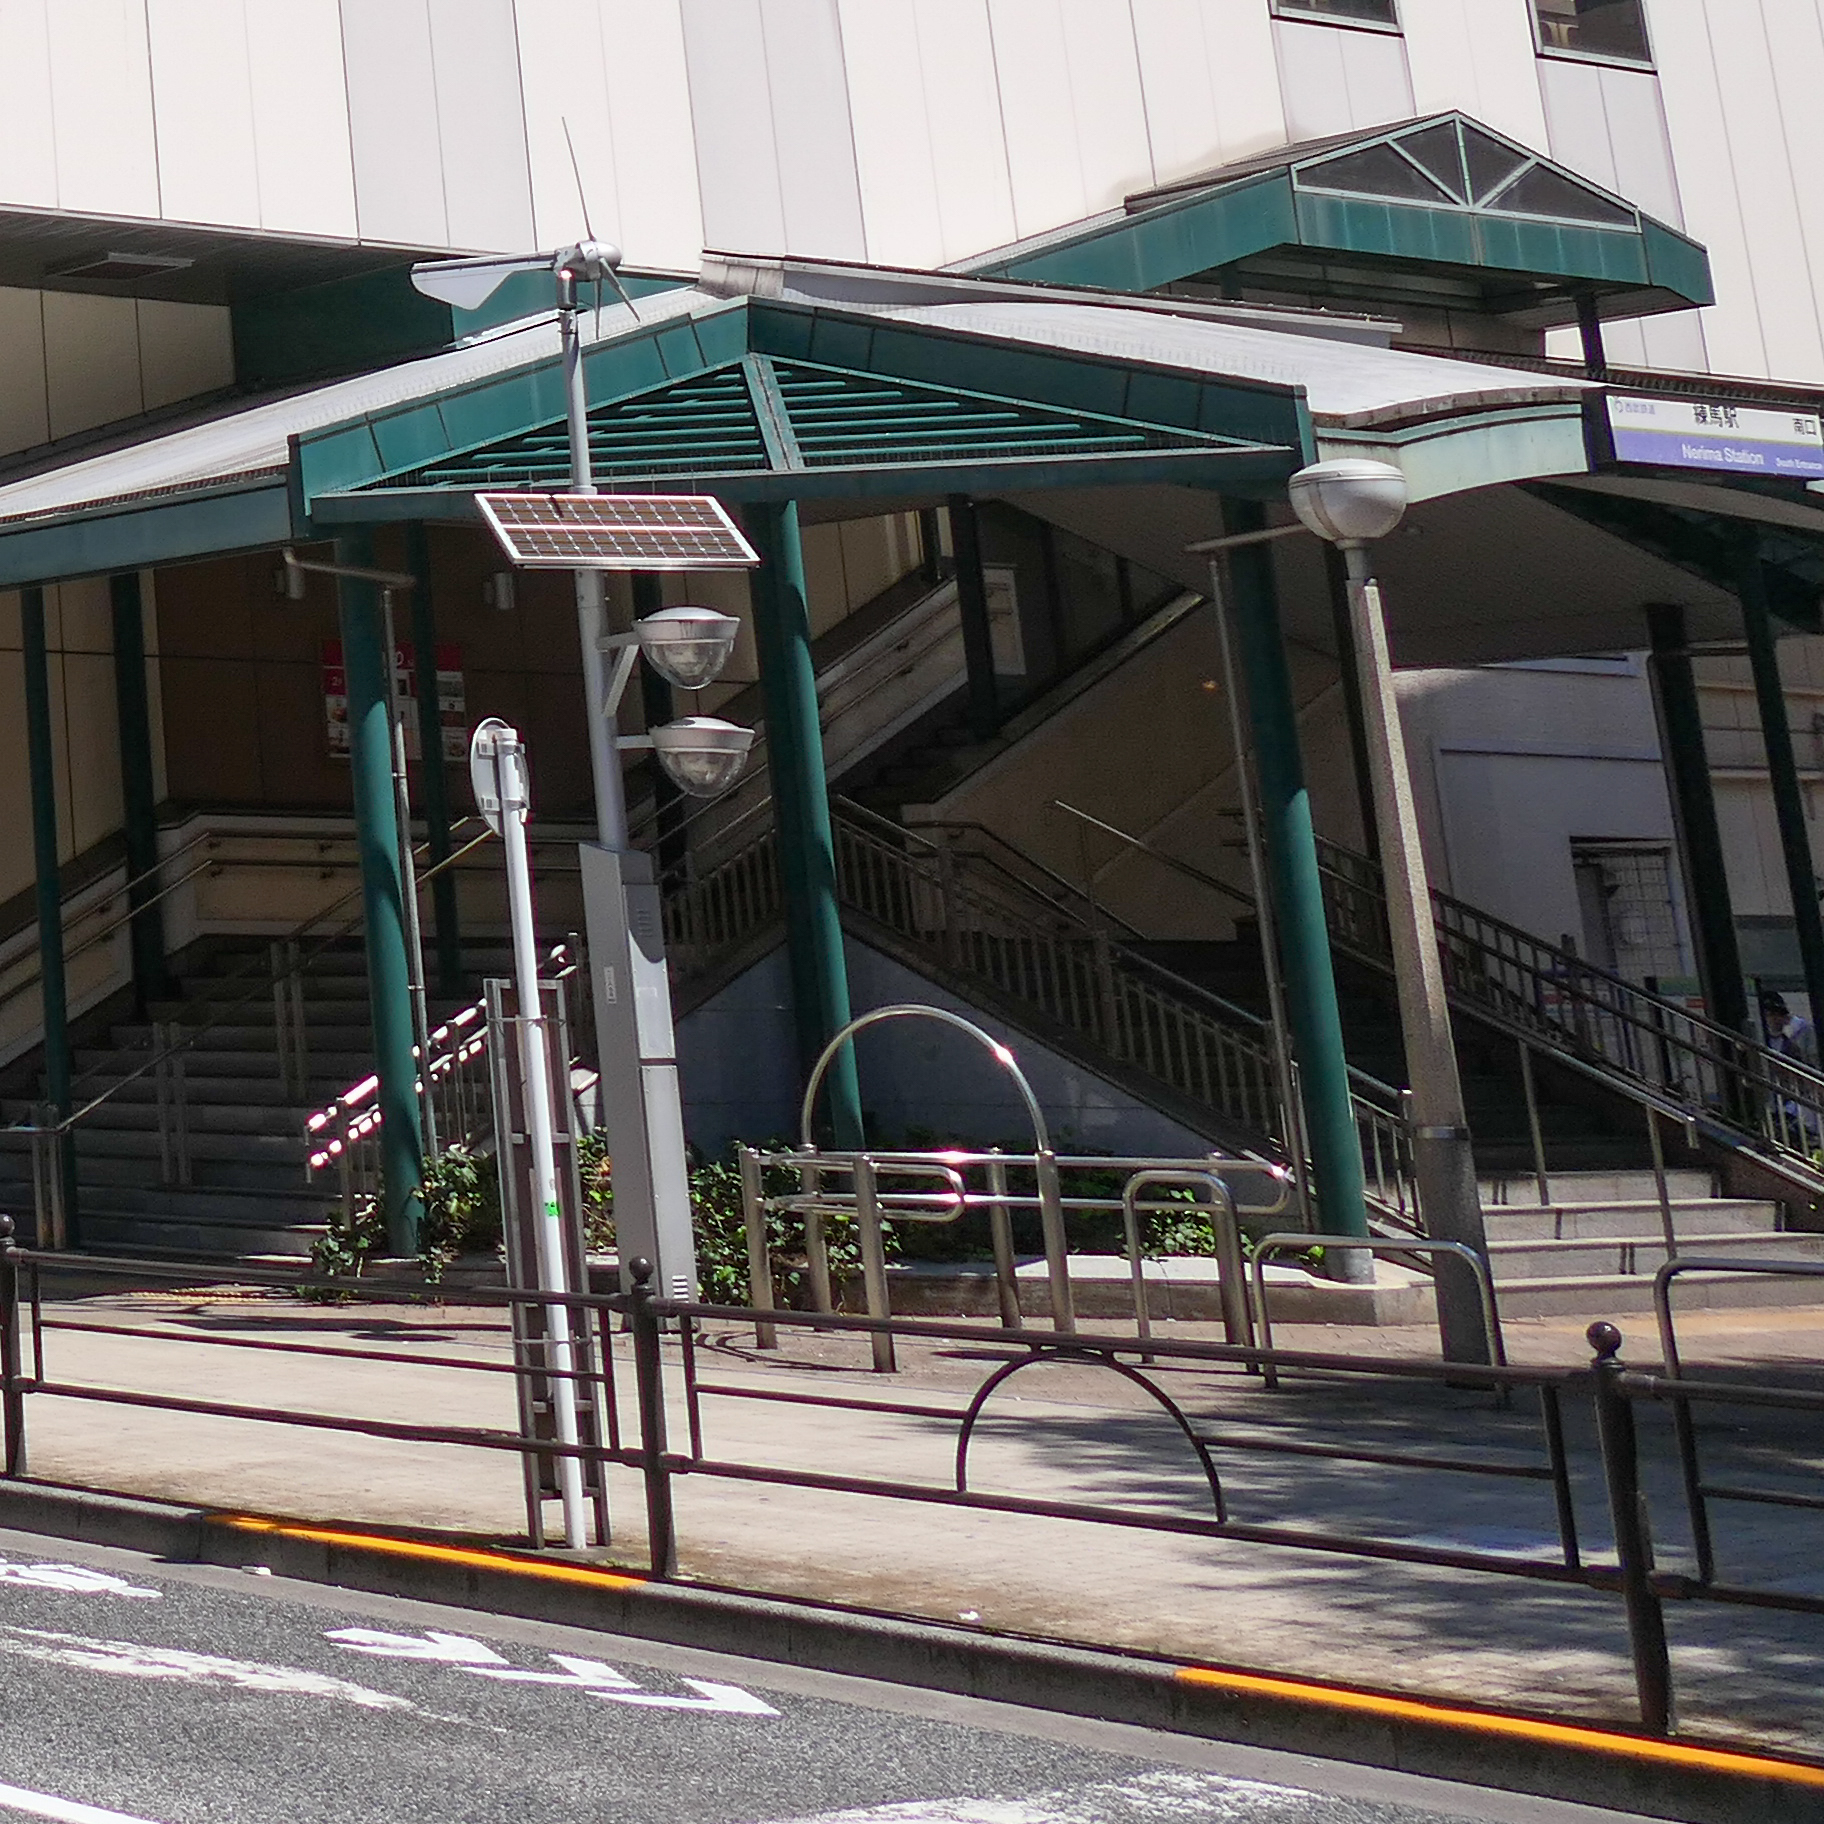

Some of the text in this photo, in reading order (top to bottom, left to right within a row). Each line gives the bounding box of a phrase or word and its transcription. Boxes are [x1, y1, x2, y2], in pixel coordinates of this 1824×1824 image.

[1693, 404, 1740, 429] 練馬駅
[1792, 417, 1817, 436] 南口
[1682, 443, 1765, 465] Nerima Station
